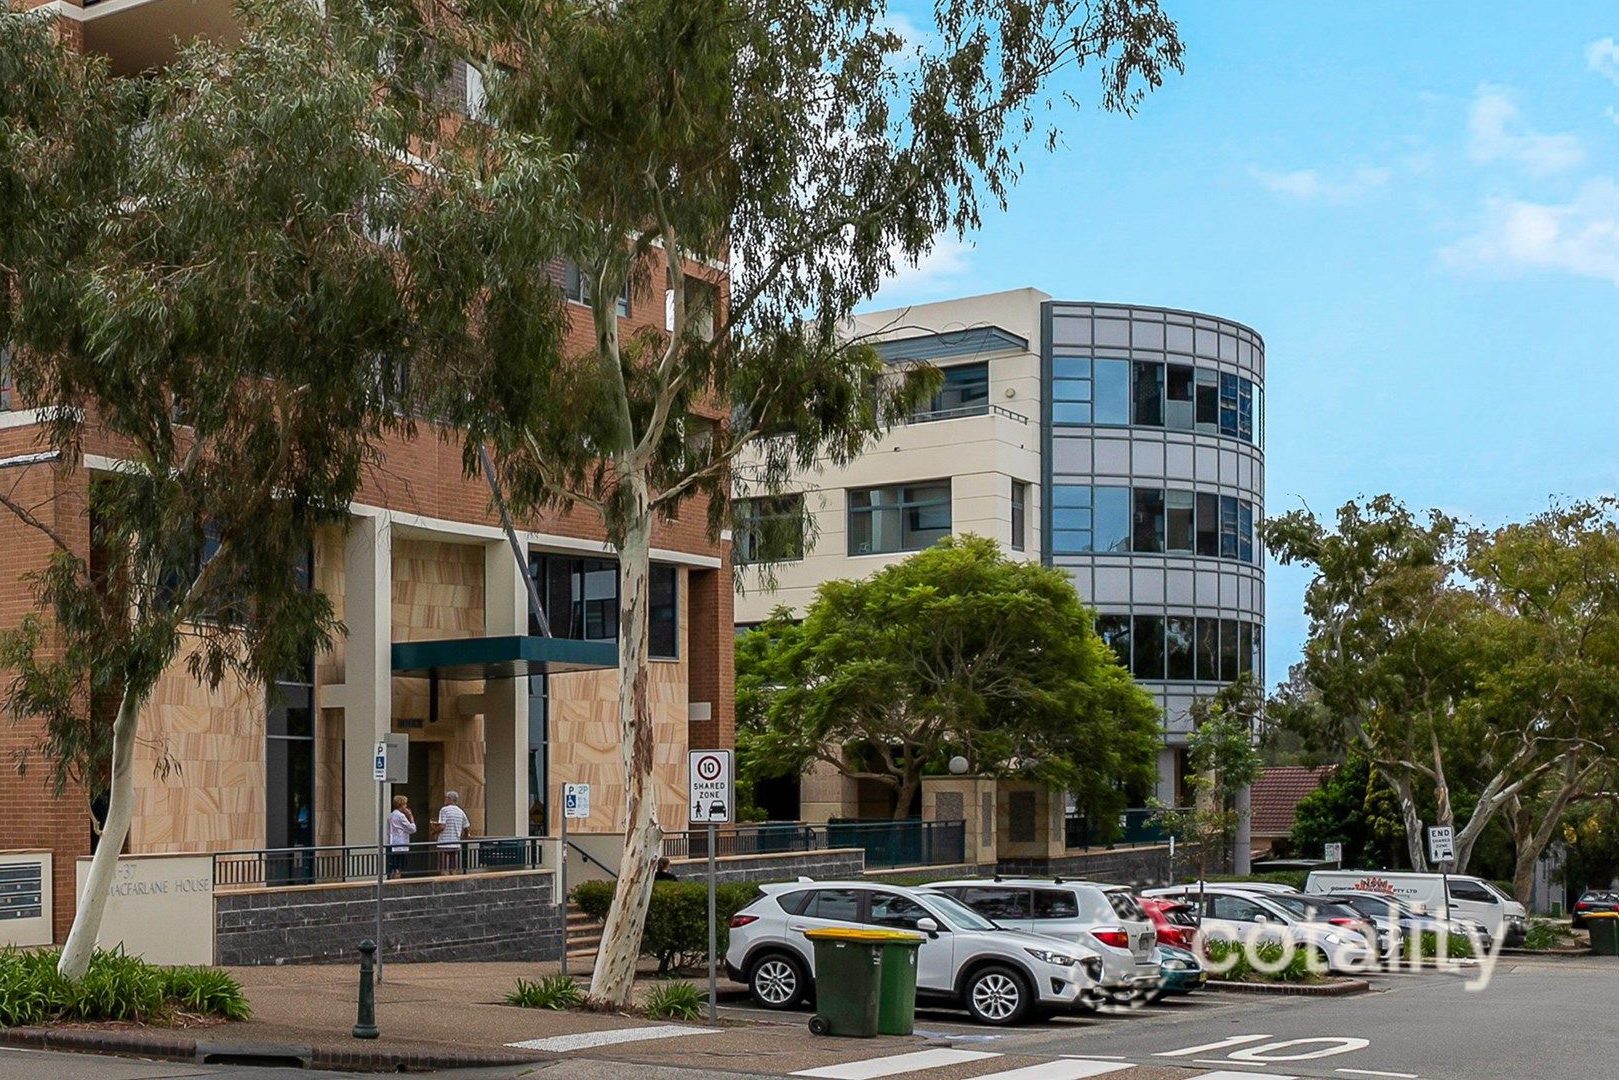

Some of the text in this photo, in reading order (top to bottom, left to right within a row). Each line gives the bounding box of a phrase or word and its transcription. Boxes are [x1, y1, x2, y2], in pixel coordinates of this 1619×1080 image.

[703, 762, 715, 774] 10
[693, 782, 726, 790] SHARED
[699, 791, 720, 799] ZONE
[1431, 829, 1450, 838] END
[114, 863, 137, 880] -37
[175, 878, 209, 893] HOUSE
[1151, 1034, 1370, 1062] 10
